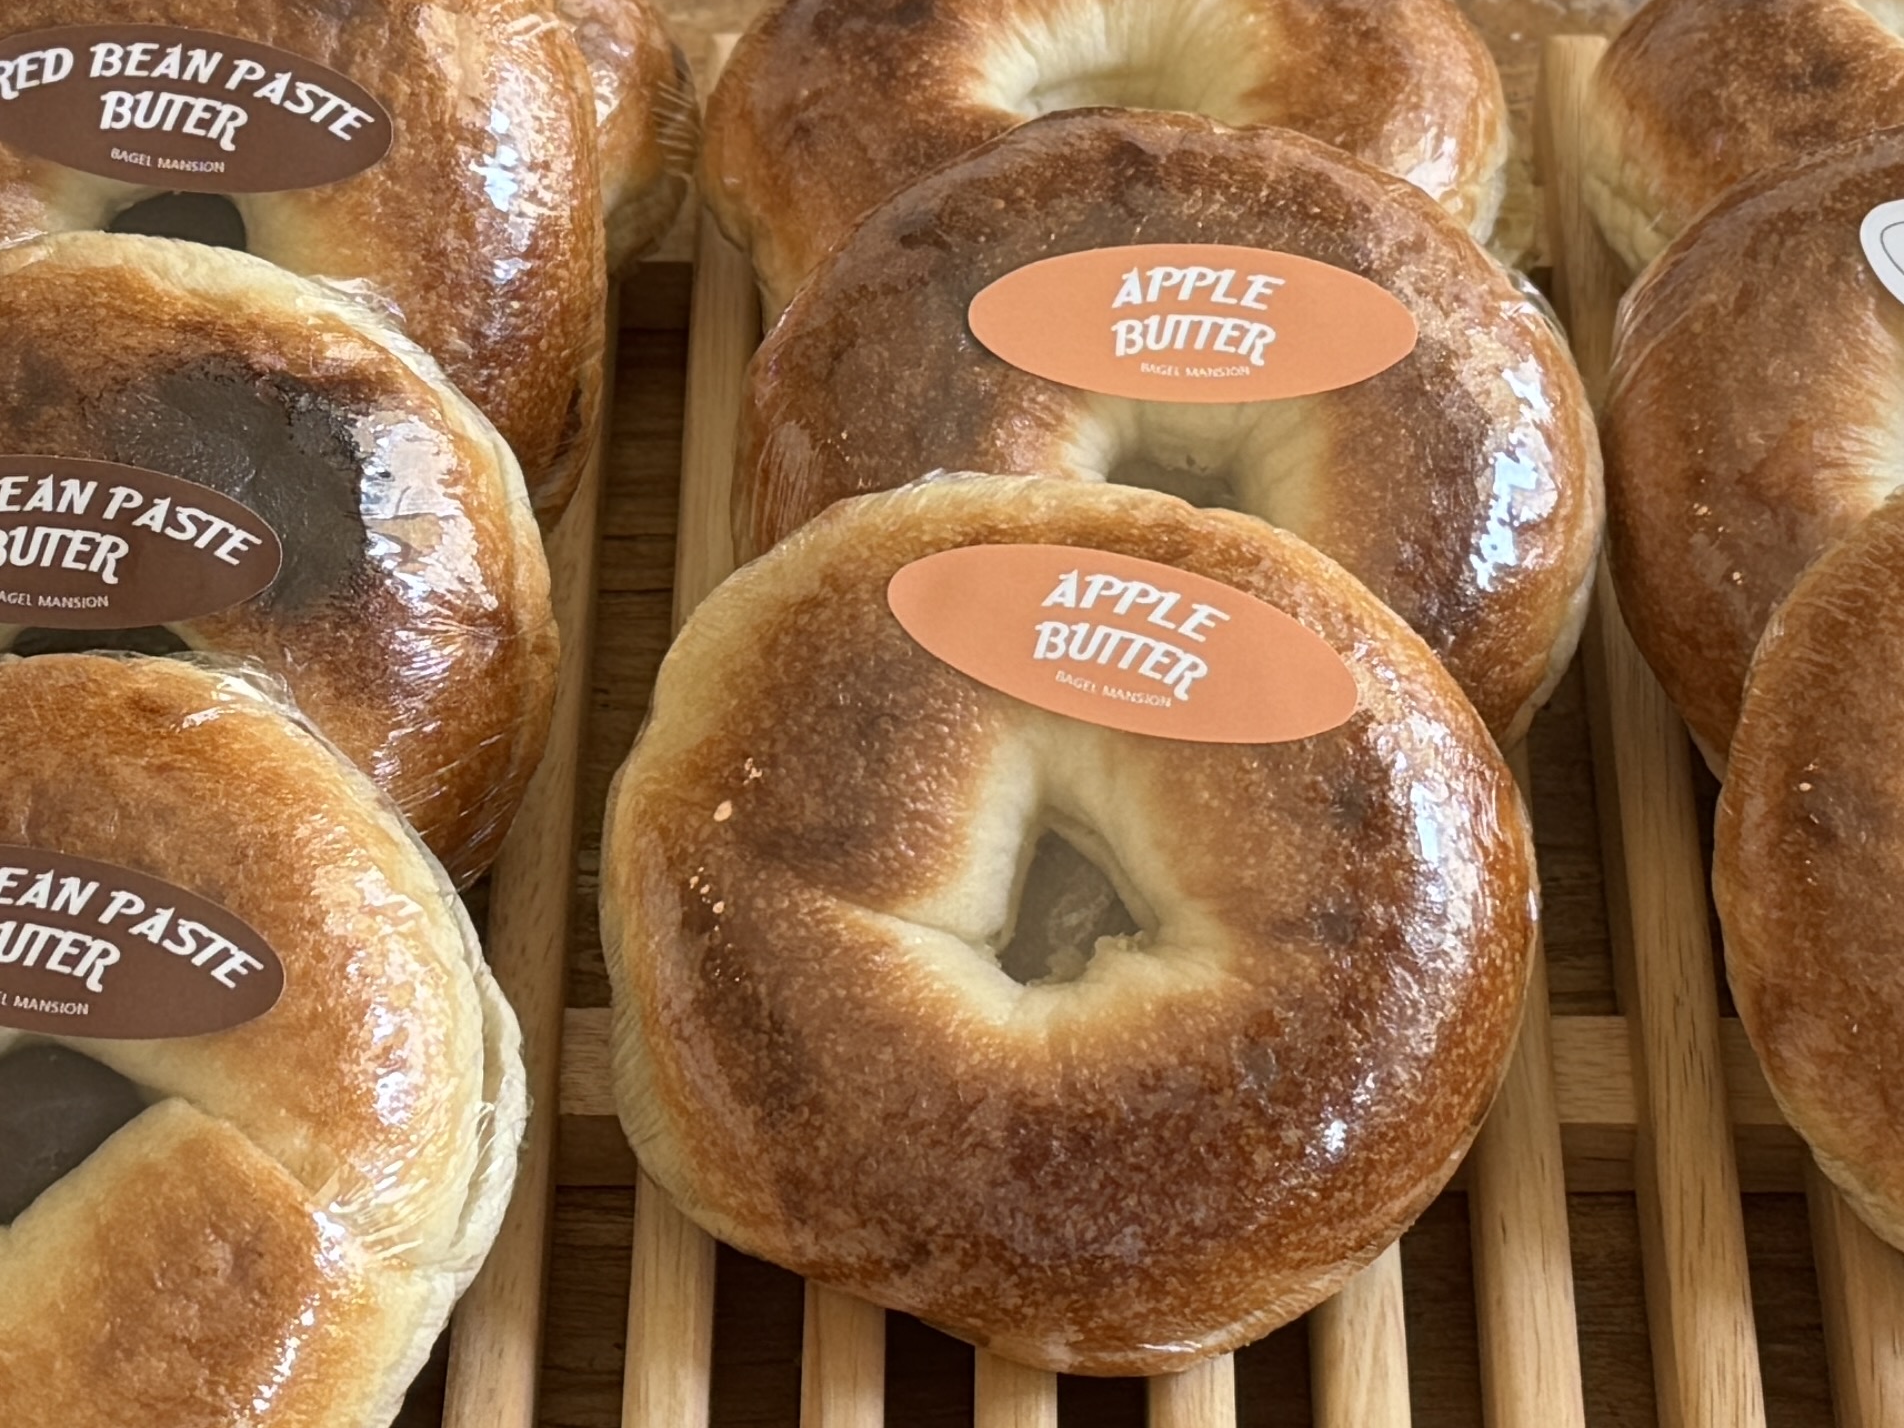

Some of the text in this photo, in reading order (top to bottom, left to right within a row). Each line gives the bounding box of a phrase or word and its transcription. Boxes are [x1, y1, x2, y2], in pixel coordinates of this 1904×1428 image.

[89, 42, 224, 86] BEAN
[225, 58, 375, 142] PASTE
[99, 90, 249, 152] BUTER
[110, 146, 226, 174] BAGEL MANSION
[1110, 265, 1286, 311] APPLE
[1110, 312, 1277, 367] BUTTER
[101, 484, 263, 567] PASTE
[37, 593, 110, 610] MANSION
[1040, 568, 1231, 643] APPLE
[1032, 620, 1209, 702] BUTTER
[1054, 669, 1172, 709] BAGEL MANSION
[97, 889, 265, 991] PASTE
[13, 994, 90, 1016] MANSION
